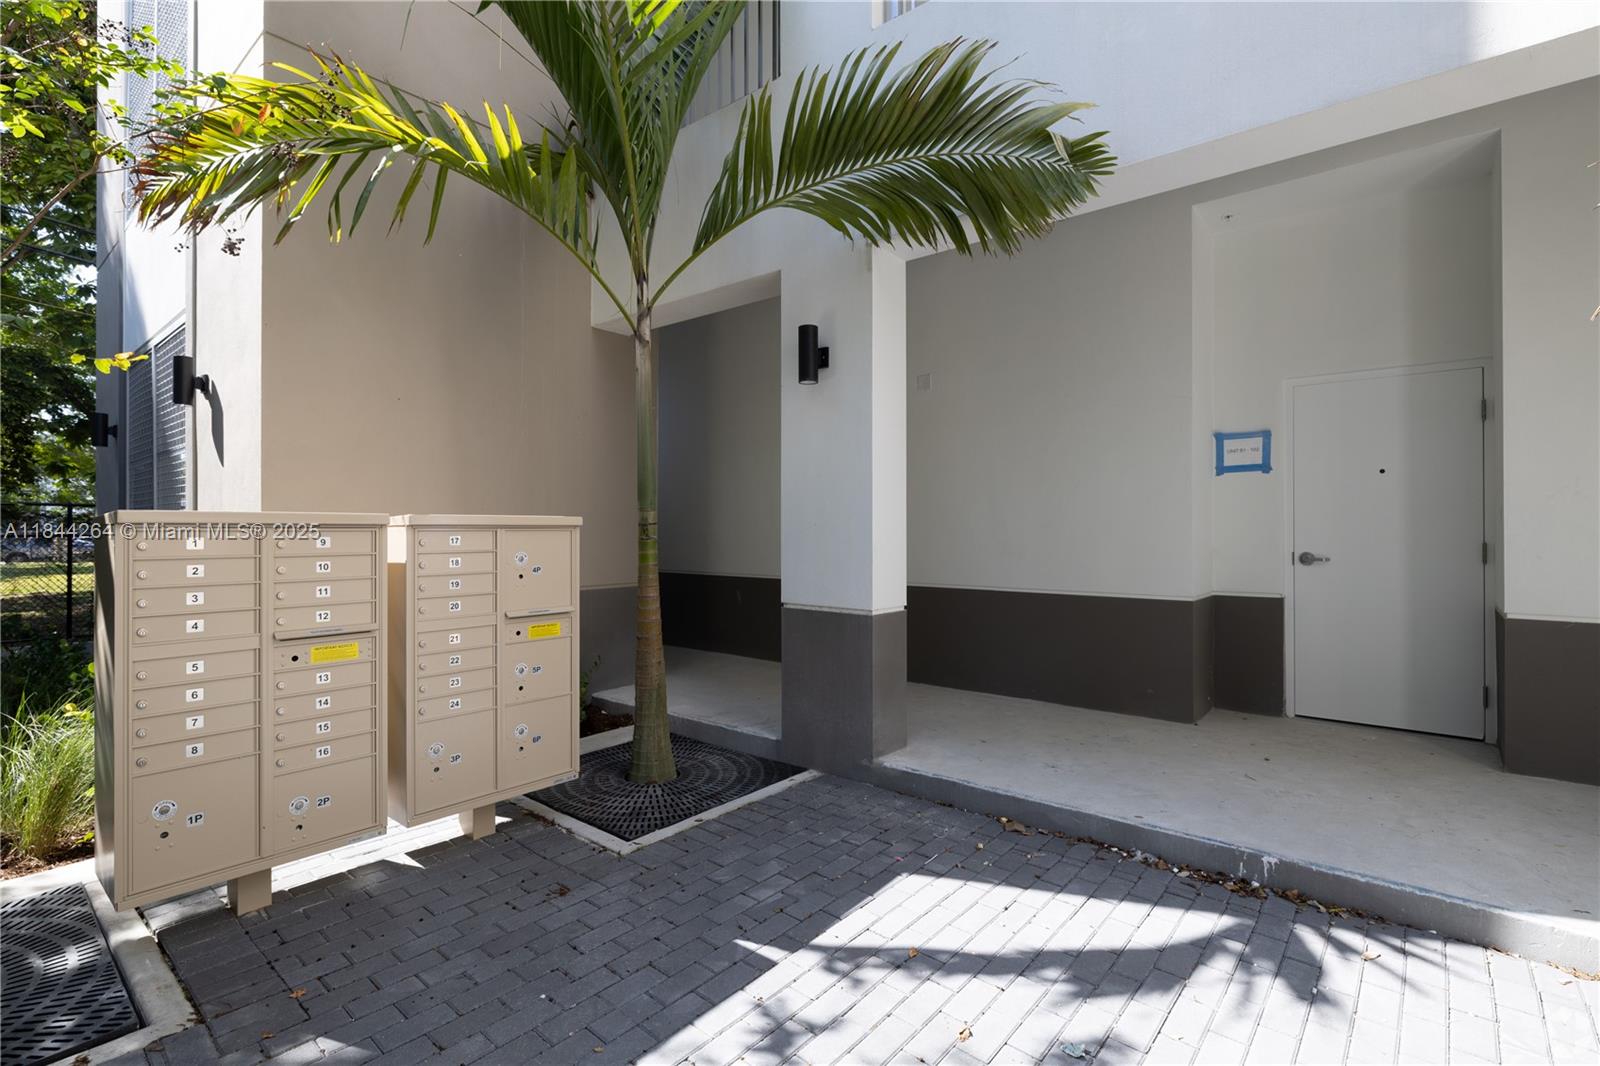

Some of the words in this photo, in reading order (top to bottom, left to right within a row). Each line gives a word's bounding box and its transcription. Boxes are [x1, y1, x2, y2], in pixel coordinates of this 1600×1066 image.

[192, 539, 198, 548] 1
[319, 538, 327, 546] 9
[191, 566, 200, 576] 2
[318, 563, 329, 571] 10
[450, 580, 460, 588] 19
[318, 587, 329, 596] 11
[191, 594, 199, 603] 3
[449, 602, 460, 610] 20
[318, 612, 329, 621] 12
[191, 622, 199, 630] 4
[449, 635, 459, 643] 21
[450, 656, 460, 664] 22
[191, 663, 199, 672] 5
[532, 665, 542, 674] 5P
[318, 673, 329, 682] 13
[450, 678, 460, 687] 23
[191, 690, 199, 700] 6
[318, 698, 329, 707] 14
[449, 700, 460, 708] 24
[191, 718, 199, 727] 7
[318, 723, 329, 732] 15
[191, 745, 199, 755] 8
[318, 747, 329, 757] 16
[450, 754, 461, 763] 3P
[316, 796, 330, 807] 2P
[187, 814, 203, 825] 1P
